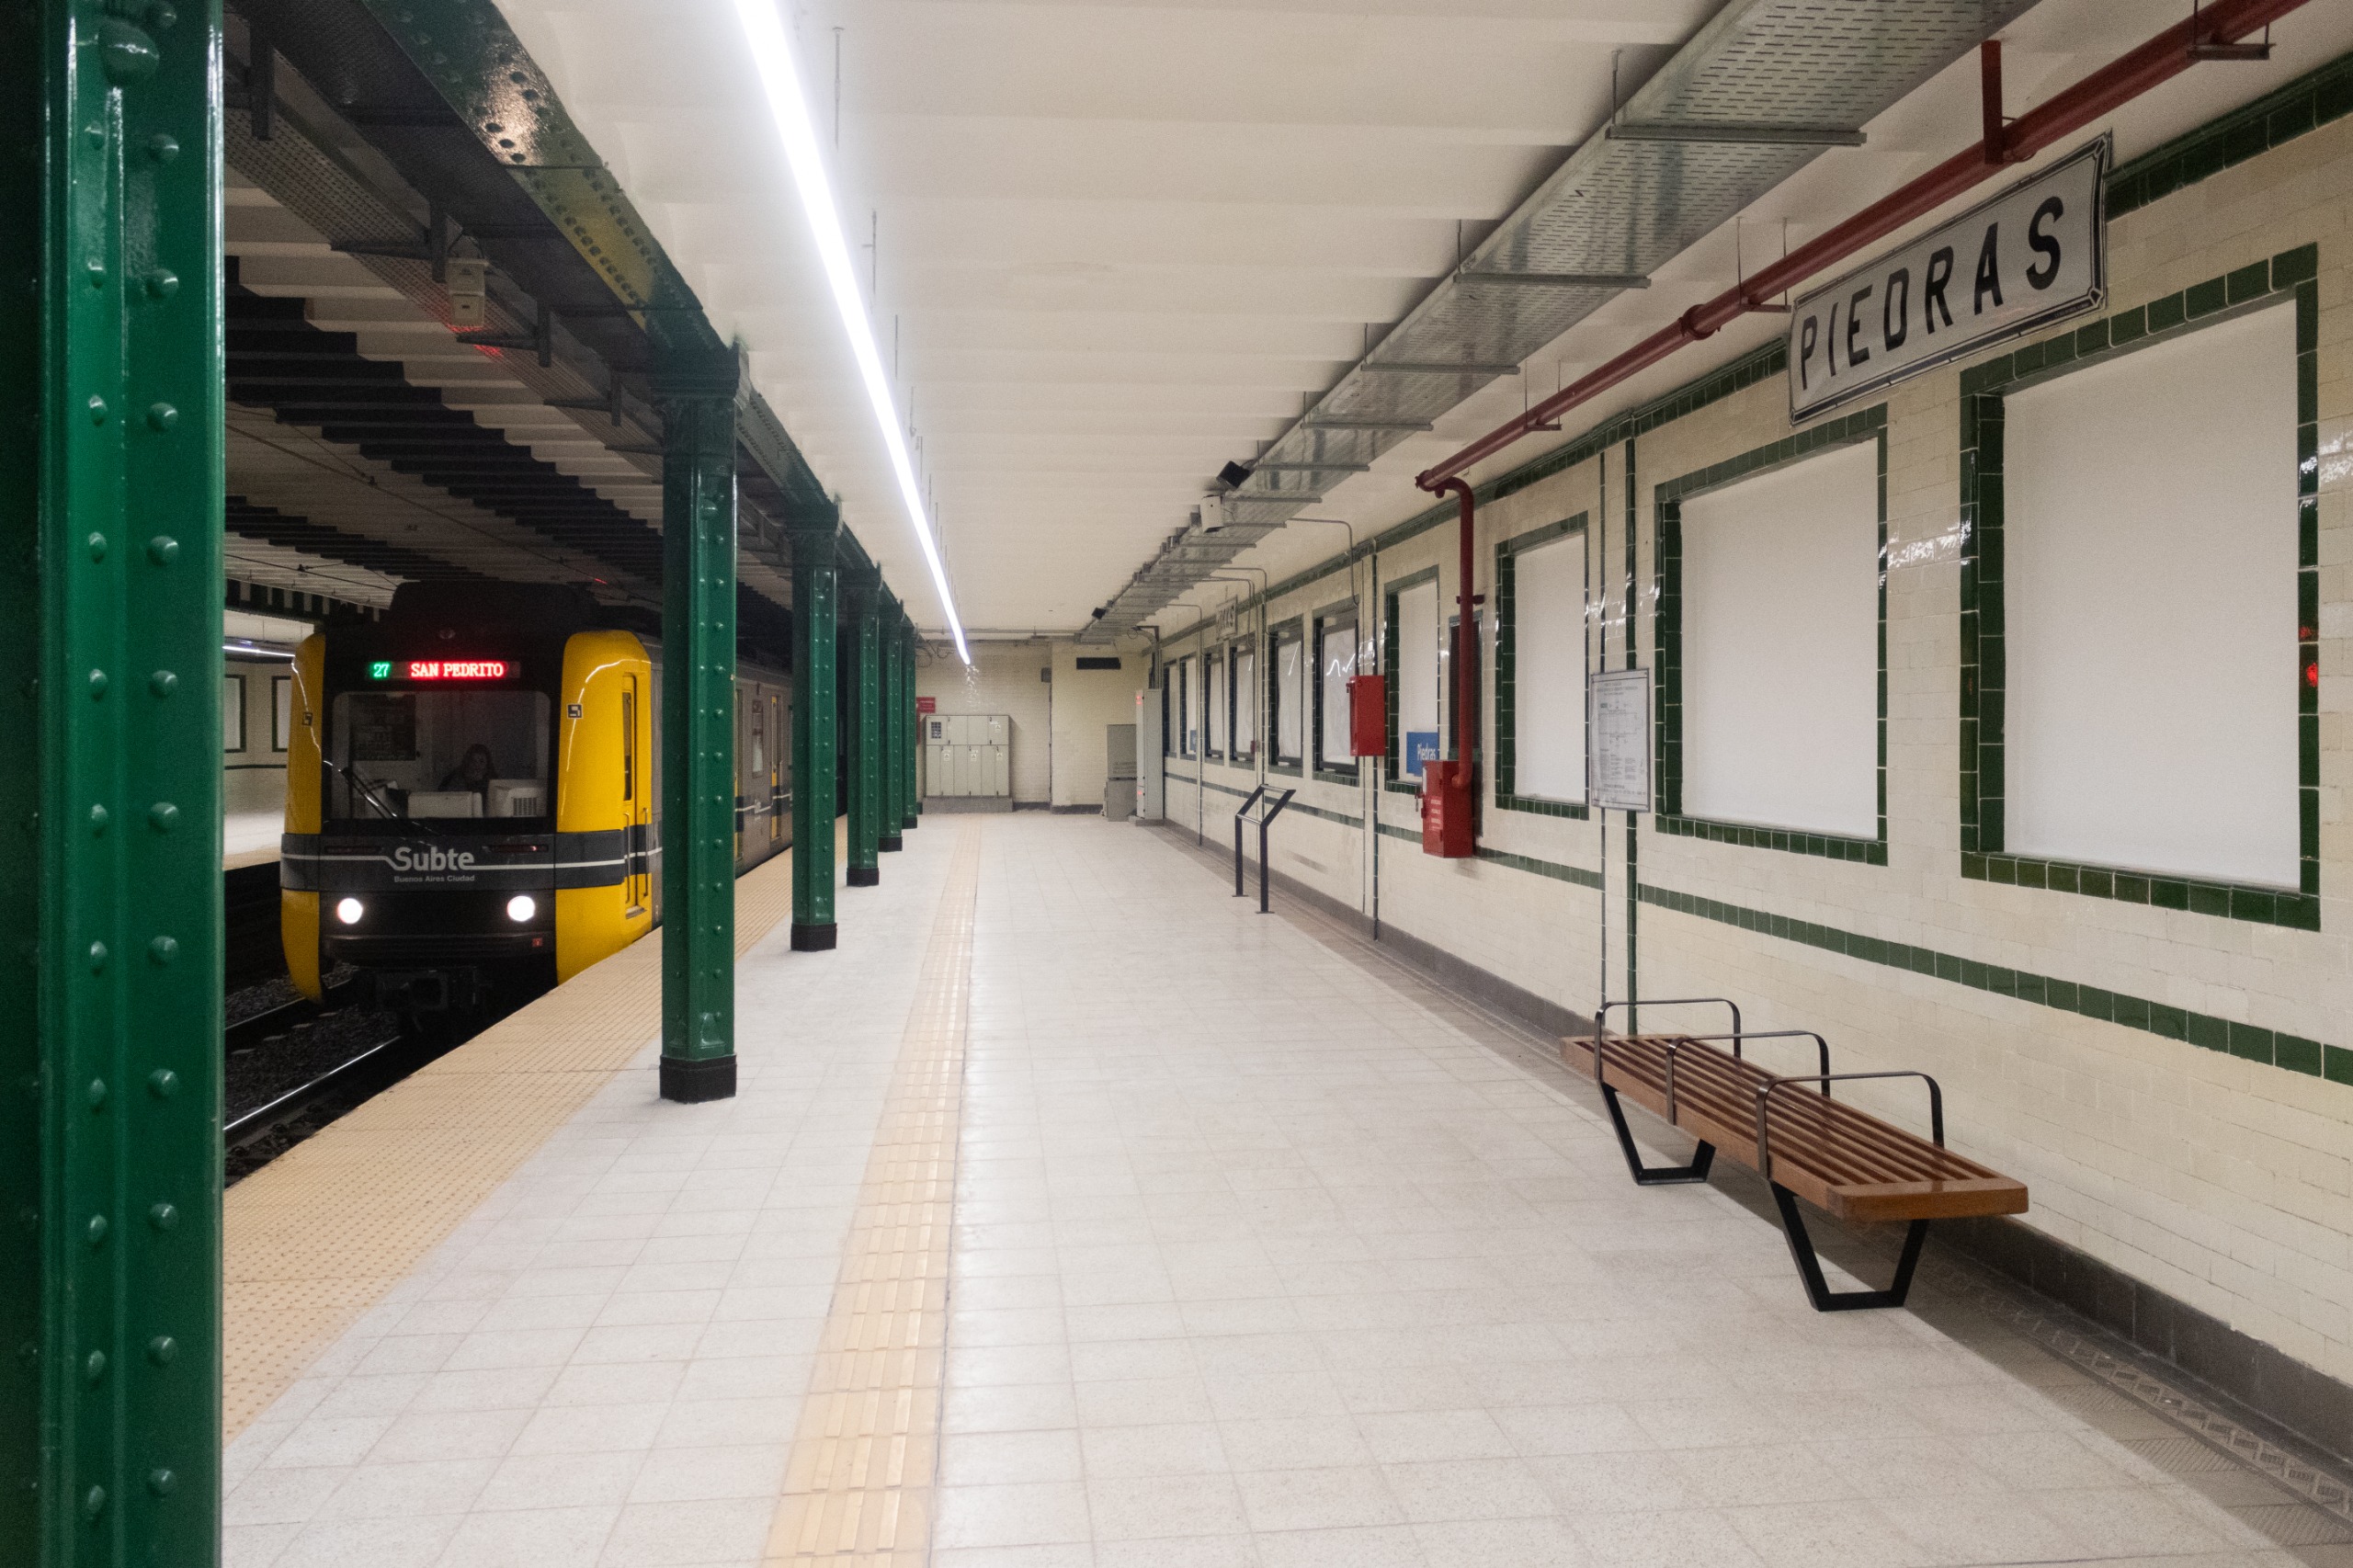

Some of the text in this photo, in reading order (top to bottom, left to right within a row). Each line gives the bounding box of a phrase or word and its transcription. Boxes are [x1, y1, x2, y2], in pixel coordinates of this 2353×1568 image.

[1800, 196, 2064, 390] PIEDRAS
[373, 663, 390, 677] 27
[411, 663, 505, 677] SAN PEDRITO
[1417, 743, 1437, 760] Piedras
[393, 846, 475, 871] Subte
